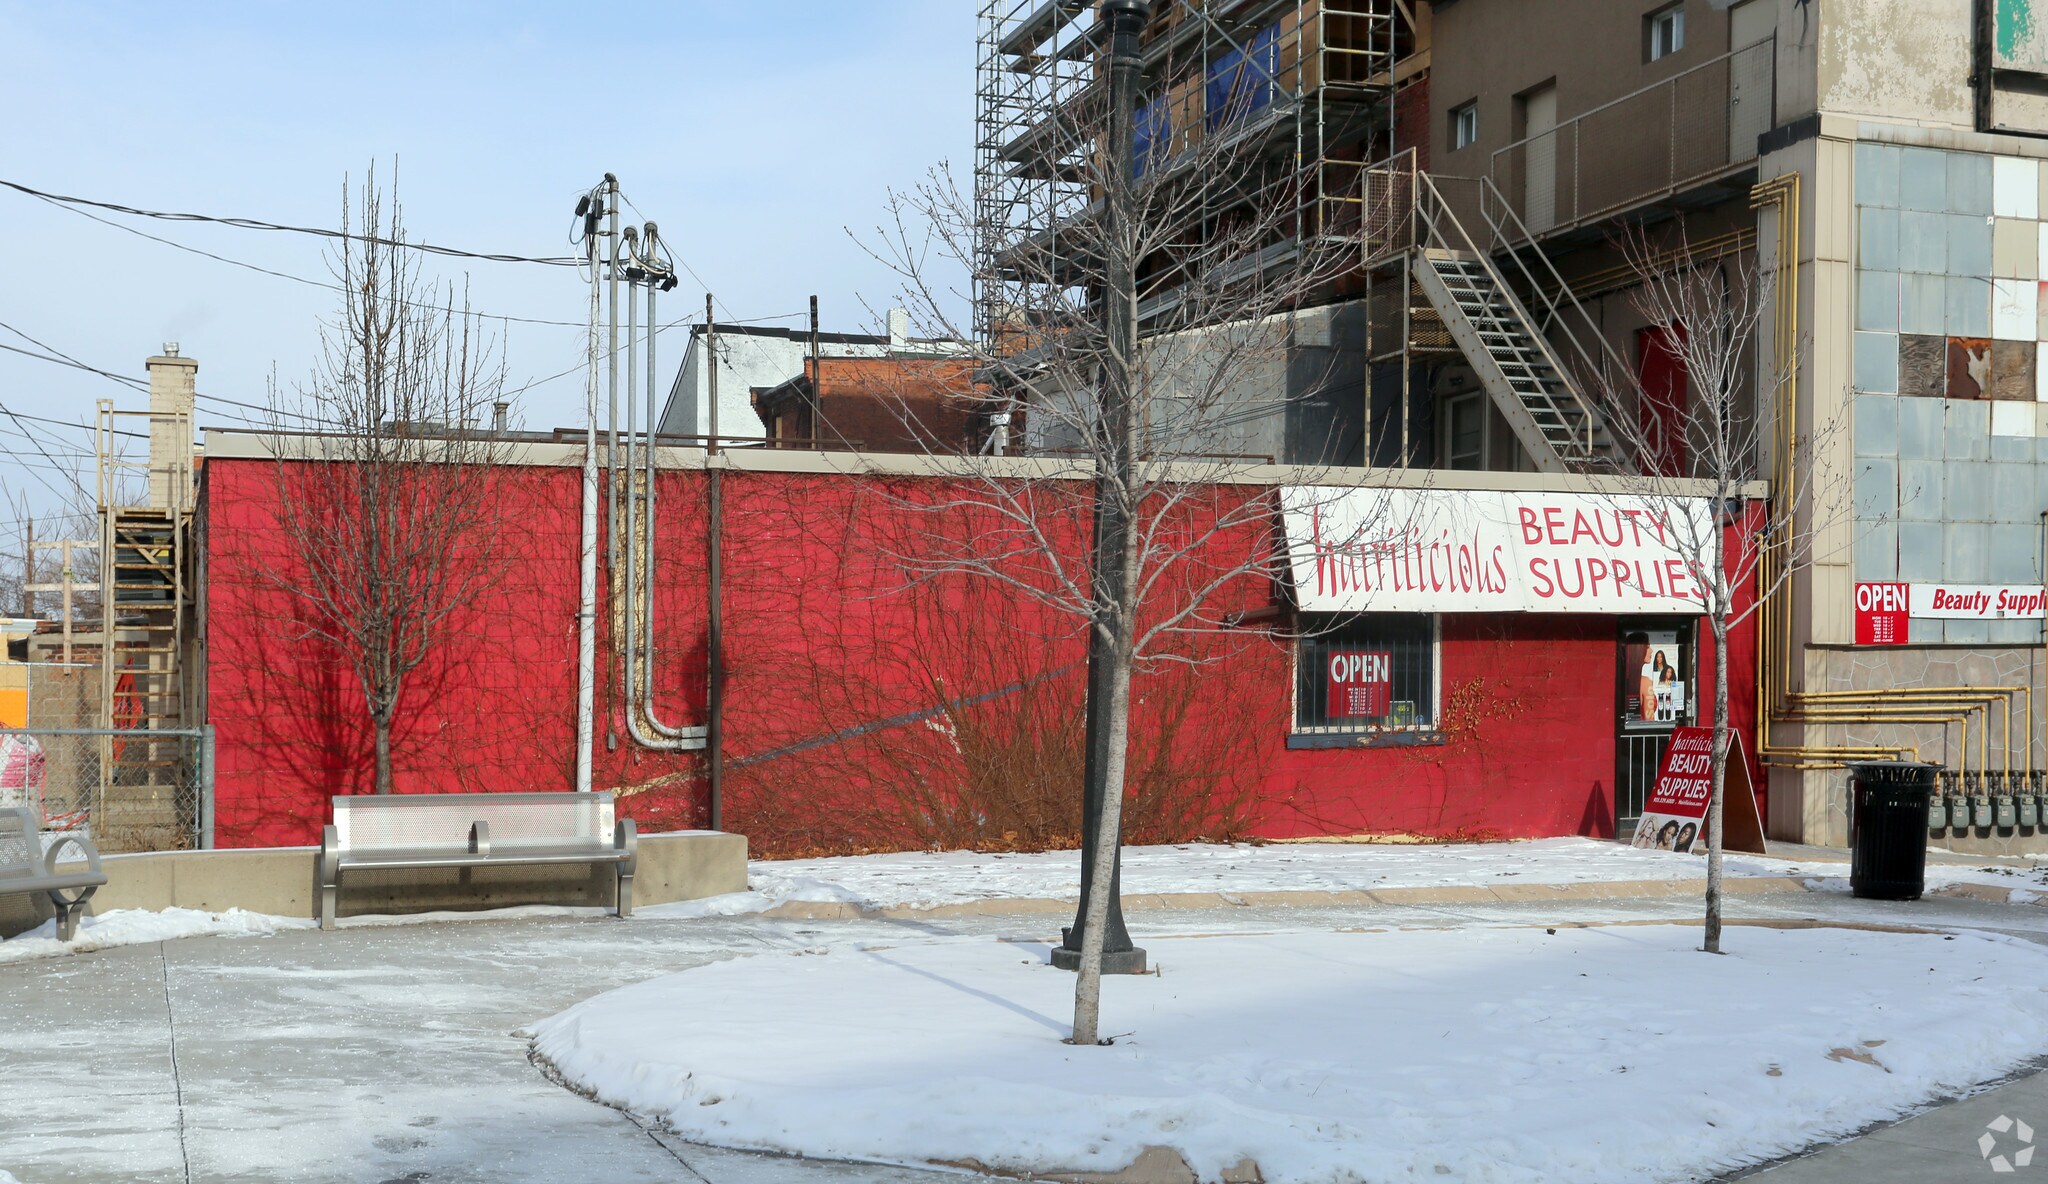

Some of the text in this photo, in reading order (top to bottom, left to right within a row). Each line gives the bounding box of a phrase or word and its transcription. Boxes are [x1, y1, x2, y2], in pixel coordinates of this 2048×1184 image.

[1518, 507, 1668, 547] BEAUTY
[1529, 557, 1711, 599] SUPPLIES
[1856, 584, 1906, 612] OPEN
[1932, 588, 1991, 615] Beauty
[1331, 654, 1388, 683] OPEN
[1668, 754, 1712, 774] BEAUTY
[1657, 776, 1710, 800] SUPPLIES
